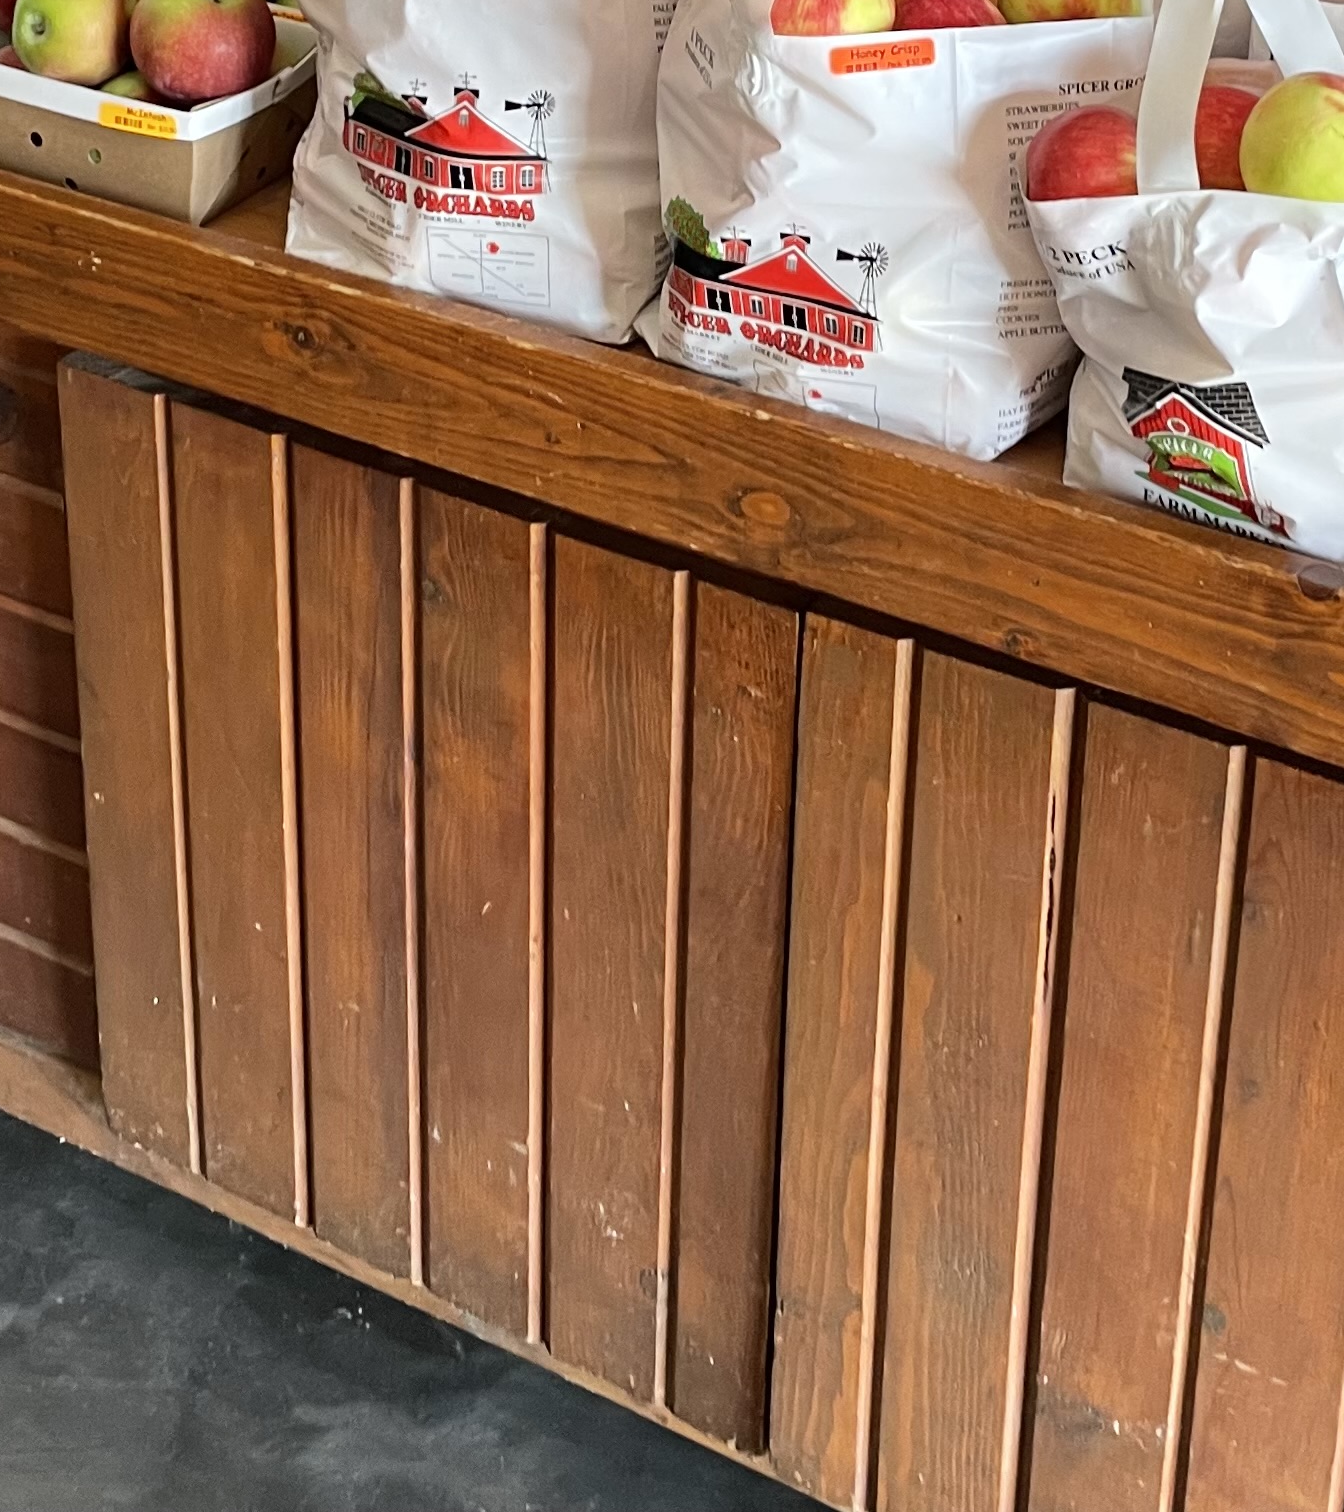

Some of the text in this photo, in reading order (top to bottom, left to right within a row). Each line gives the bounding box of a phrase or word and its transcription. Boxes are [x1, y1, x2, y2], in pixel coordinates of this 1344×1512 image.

[850, 43, 920, 61] Honey Crisp
[1058, 74, 1146, 97] SPICER GRO
[1006, 101, 1080, 117] STRAWBERRIES
[1007, 120, 1038, 131] SWEET
[413, 185, 536, 222] ORCHARDS
[1062, 240, 1127, 266] PECK
[1088, 259, 1136, 280] of USA
[1022, 289, 1056, 300] DONUT
[739, 320, 865, 369] ORCHARDS
[997, 328, 1027, 339] APPLE
[1154, 437, 1214, 461] SPICER
[1143, 487, 1199, 521] FARM
